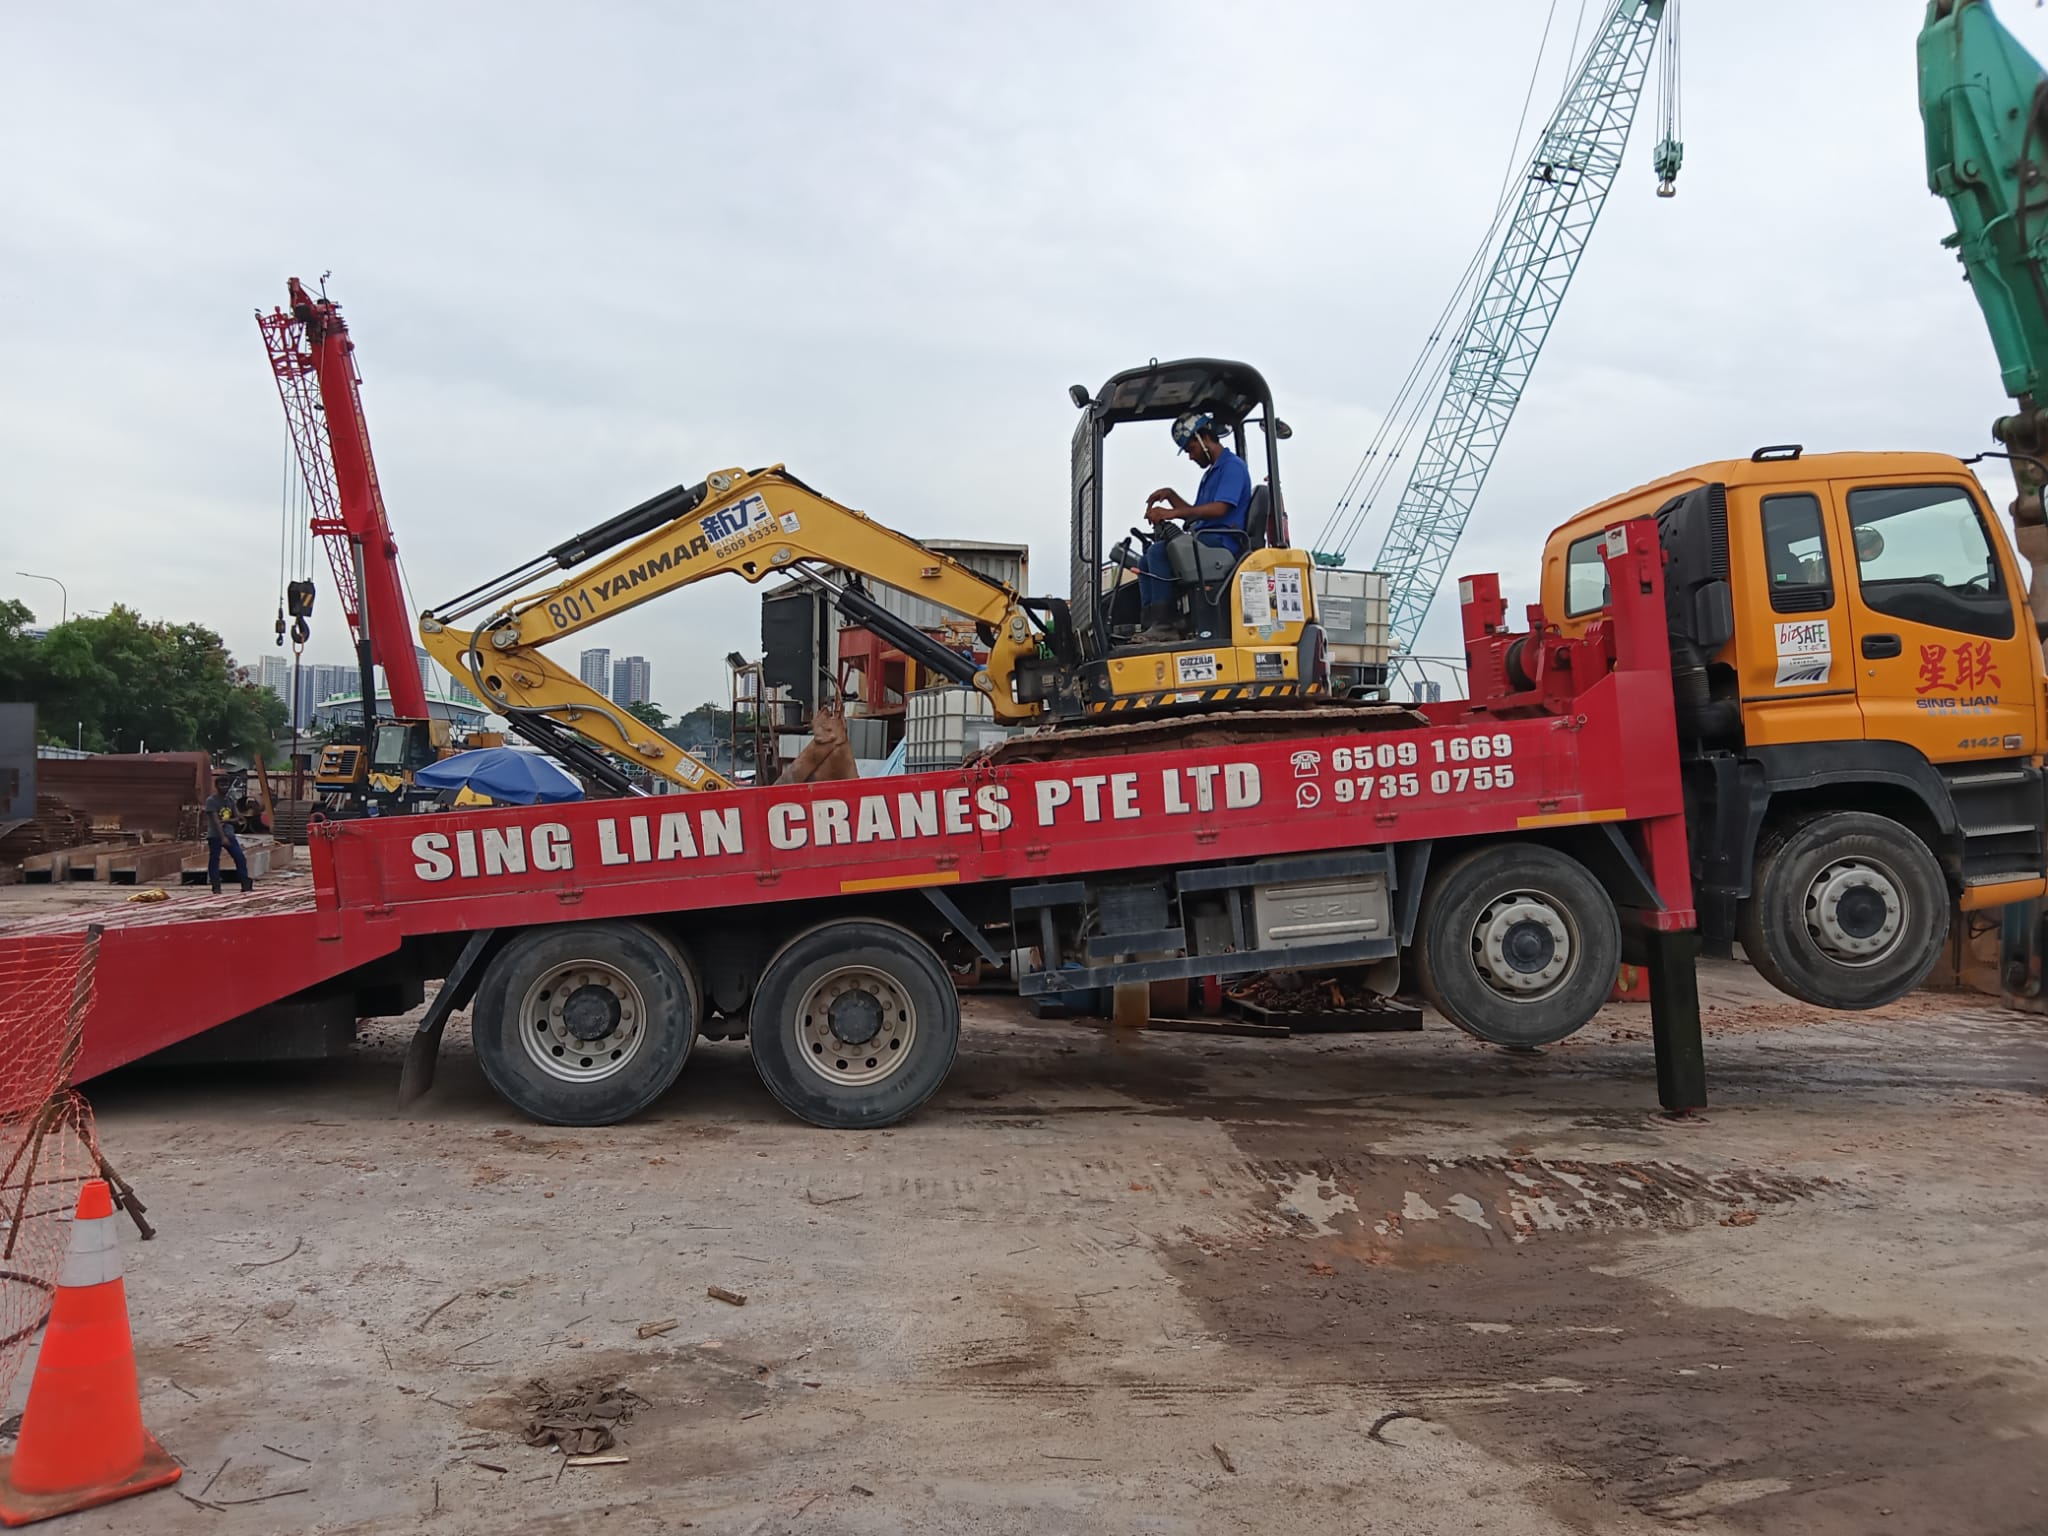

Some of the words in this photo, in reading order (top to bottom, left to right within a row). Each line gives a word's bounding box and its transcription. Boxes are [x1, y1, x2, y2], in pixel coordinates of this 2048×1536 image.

[700, 495, 767, 544] 新力
[716, 538, 747, 559] 6509
[747, 522, 778, 543] 6335
[592, 535, 709, 602] YANMAR
[549, 589, 596, 629] 801
[1915, 640, 2002, 694] 星联
[1916, 697, 1956, 709] SING
[1960, 695, 1999, 707] LIAN
[1332, 742, 1418, 772] 6509
[1431, 733, 1513, 763] 1669
[1957, 736, 2000, 749] 4142
[1334, 773, 1420, 803] 9735
[1431, 764, 1515, 795] 0755
[411, 823, 574, 882] SING
[597, 807, 744, 866] LIAN
[767, 784, 1012, 850] CRANES
[1034, 771, 1142, 826] PTE
[1161, 763, 1262, 815] LTD
